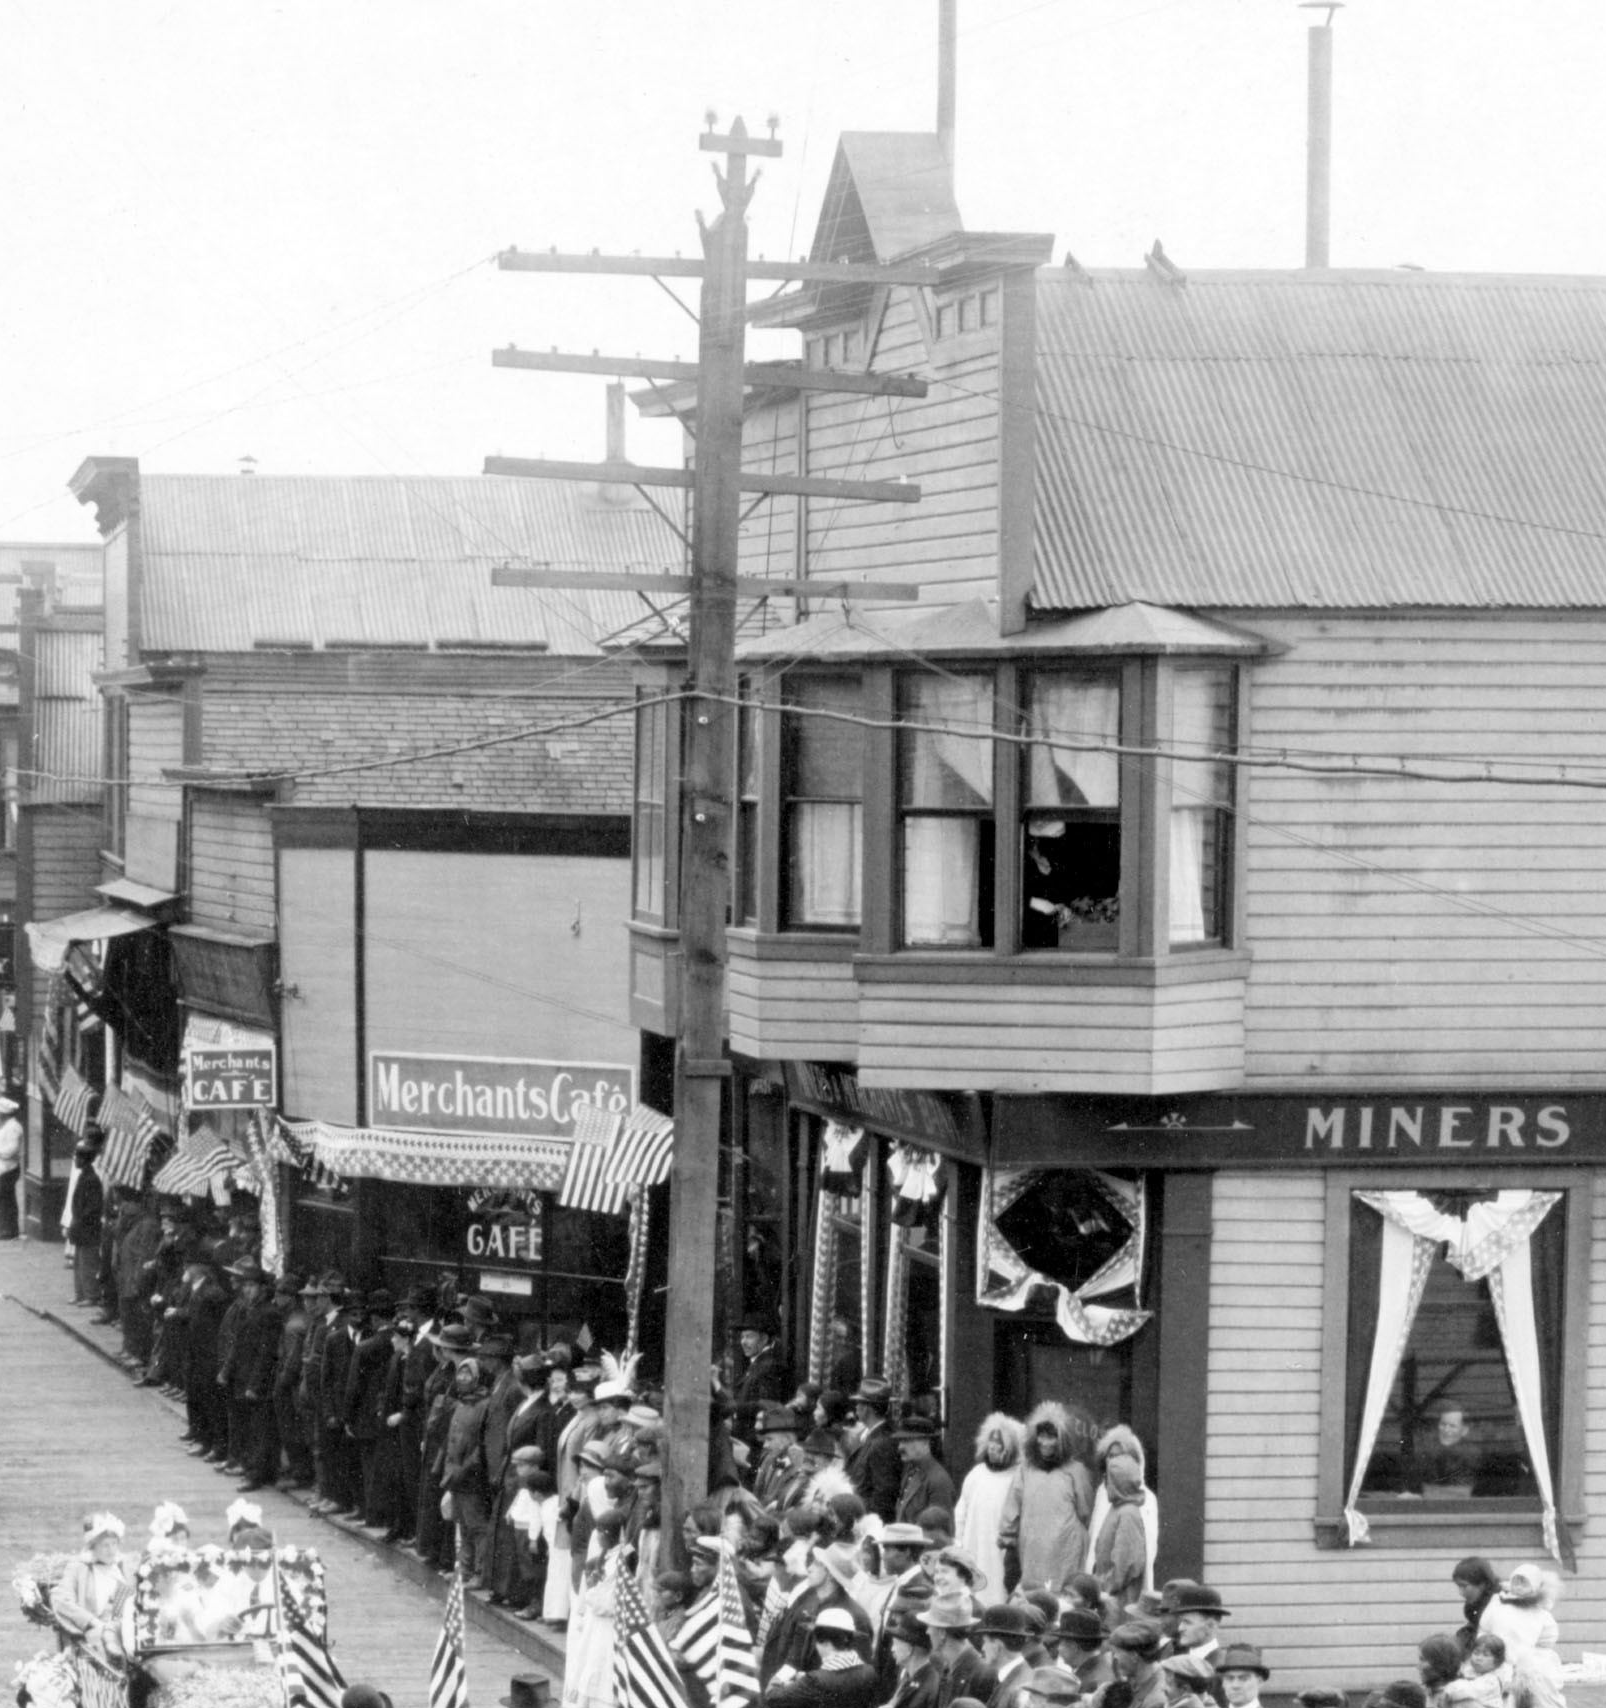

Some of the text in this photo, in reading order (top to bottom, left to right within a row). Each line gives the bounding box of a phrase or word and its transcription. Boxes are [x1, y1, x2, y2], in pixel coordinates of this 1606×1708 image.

[193, 1053, 271, 1071] Merchants
[194, 1074, 271, 1101] CAFÉ
[377, 1061, 549, 1120] Merchants
[1305, 1106, 1570, 1148] MINERS
